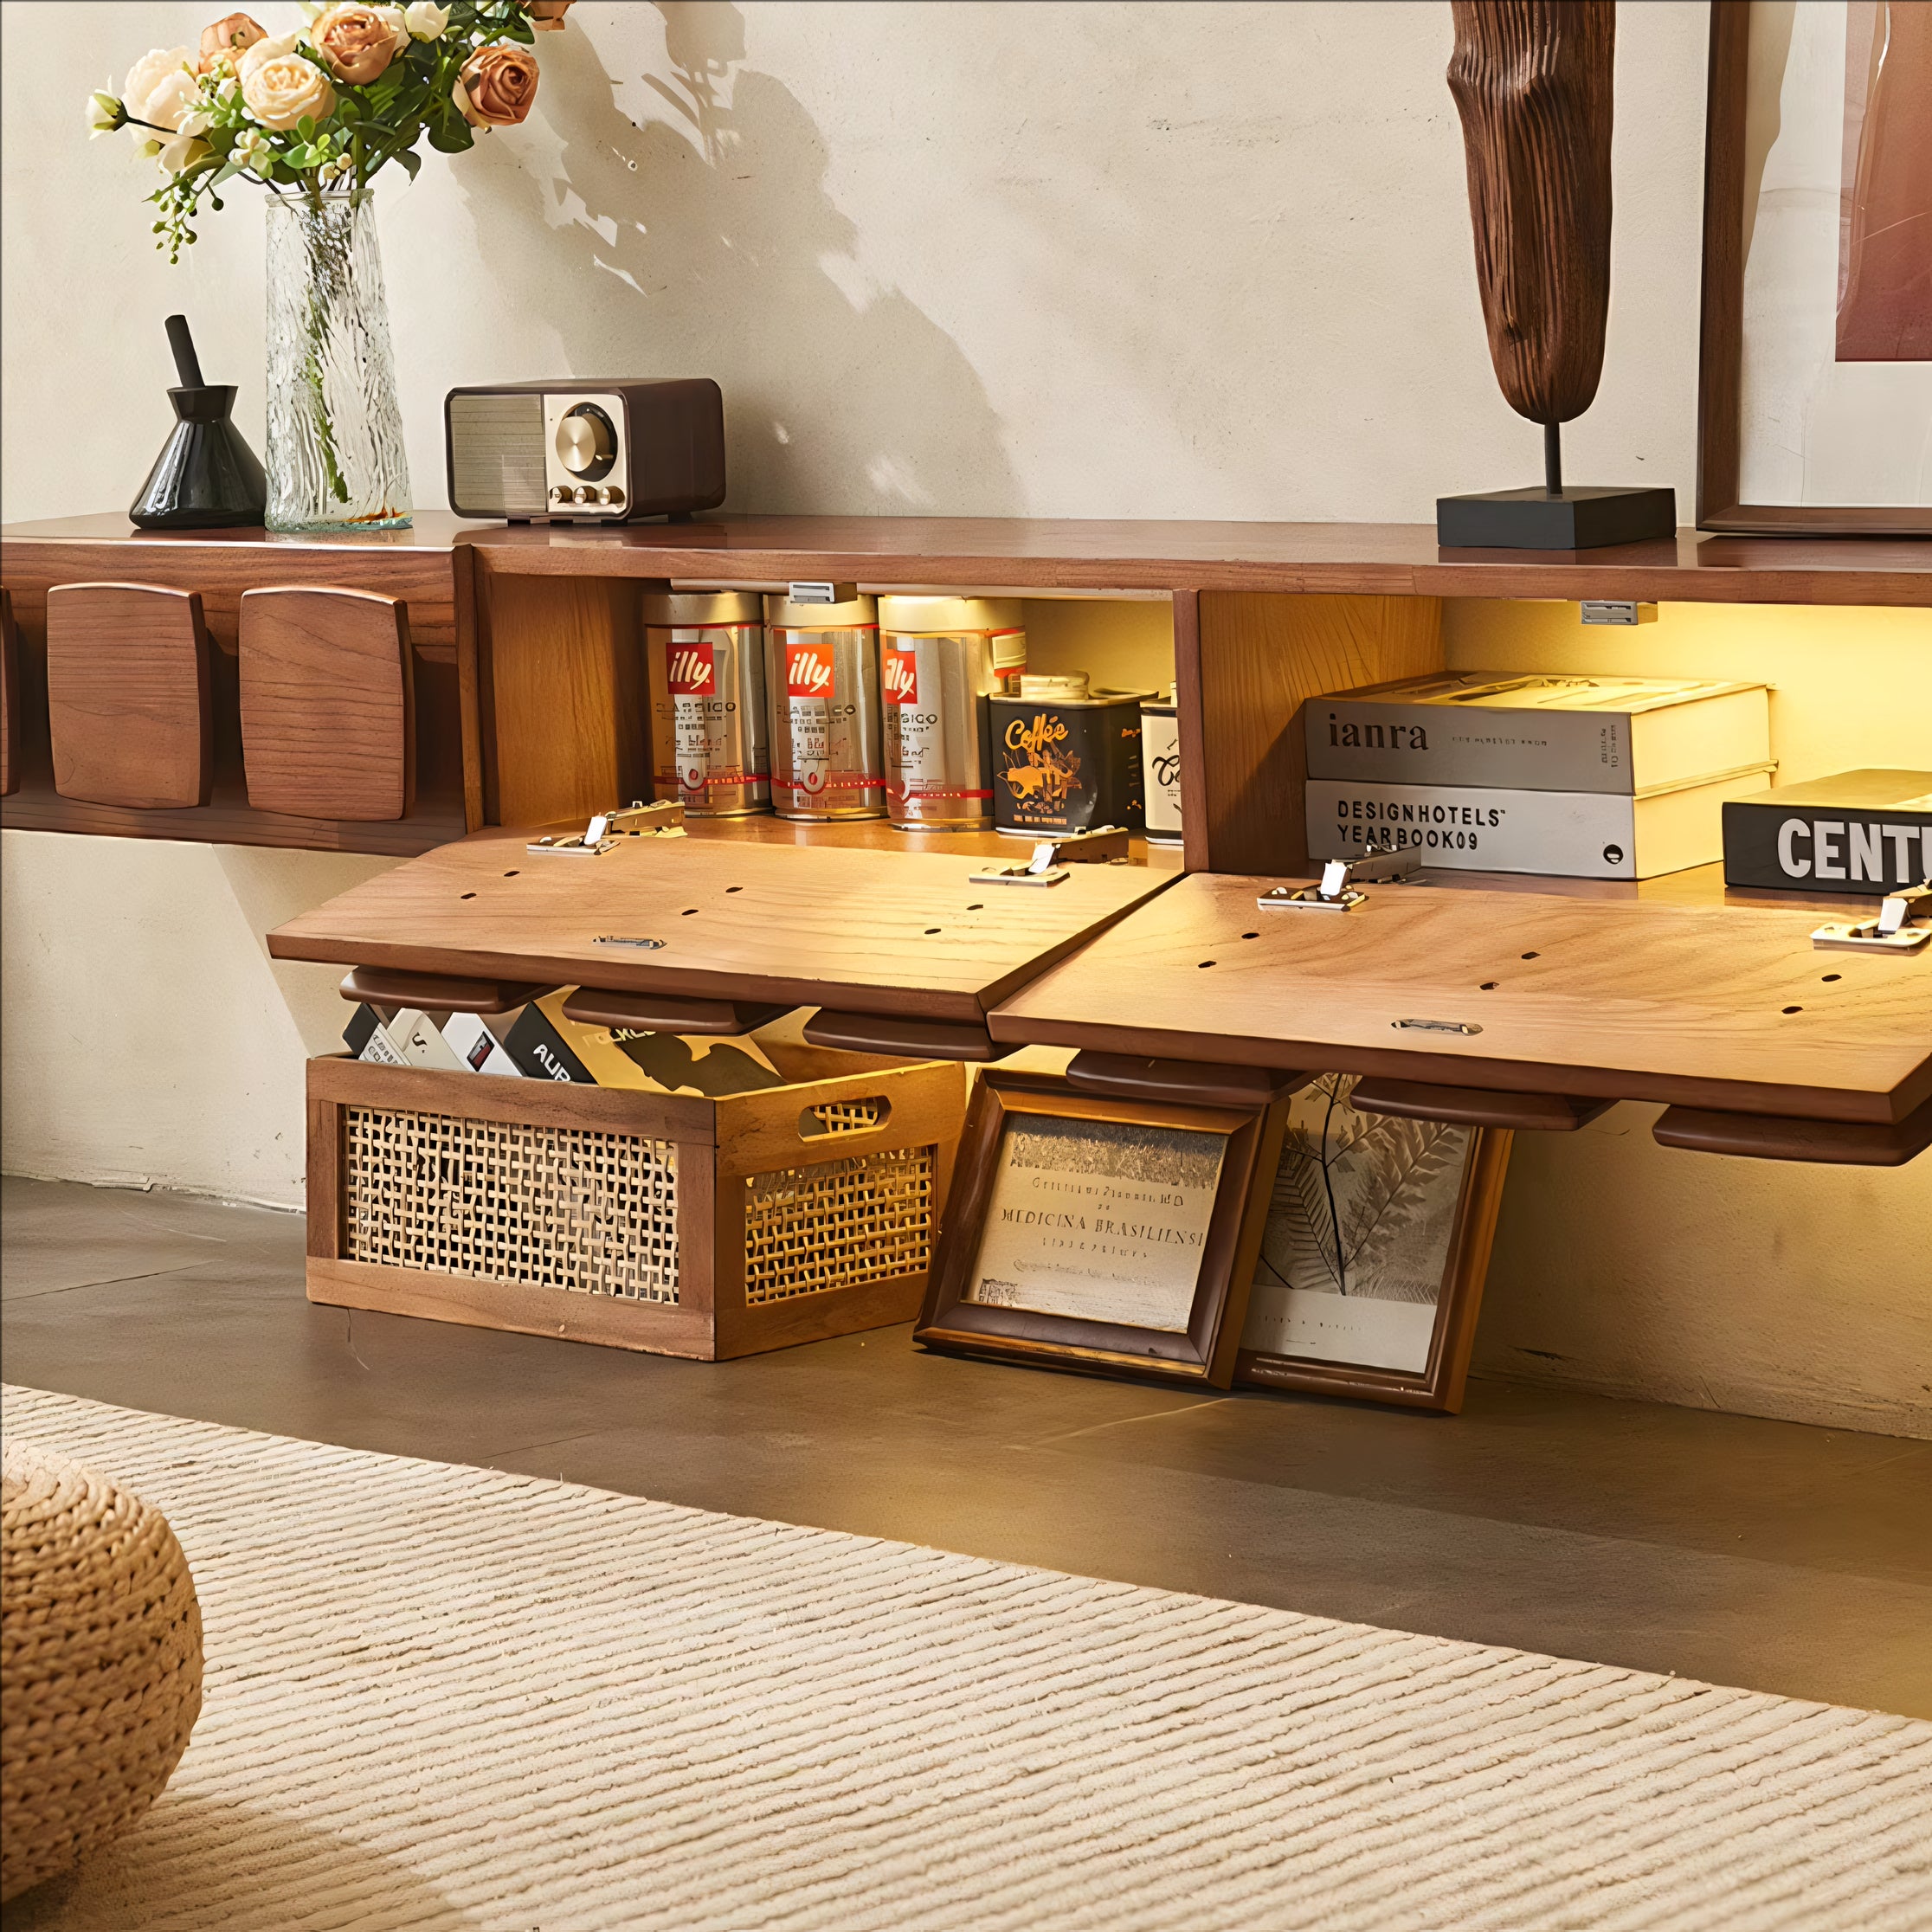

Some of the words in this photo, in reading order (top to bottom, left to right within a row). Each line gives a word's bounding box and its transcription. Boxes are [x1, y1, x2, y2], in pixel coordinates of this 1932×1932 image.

[669, 650, 712, 691] illy
[789, 652, 831, 693] illy
[1329, 712, 1429, 751] ianra
